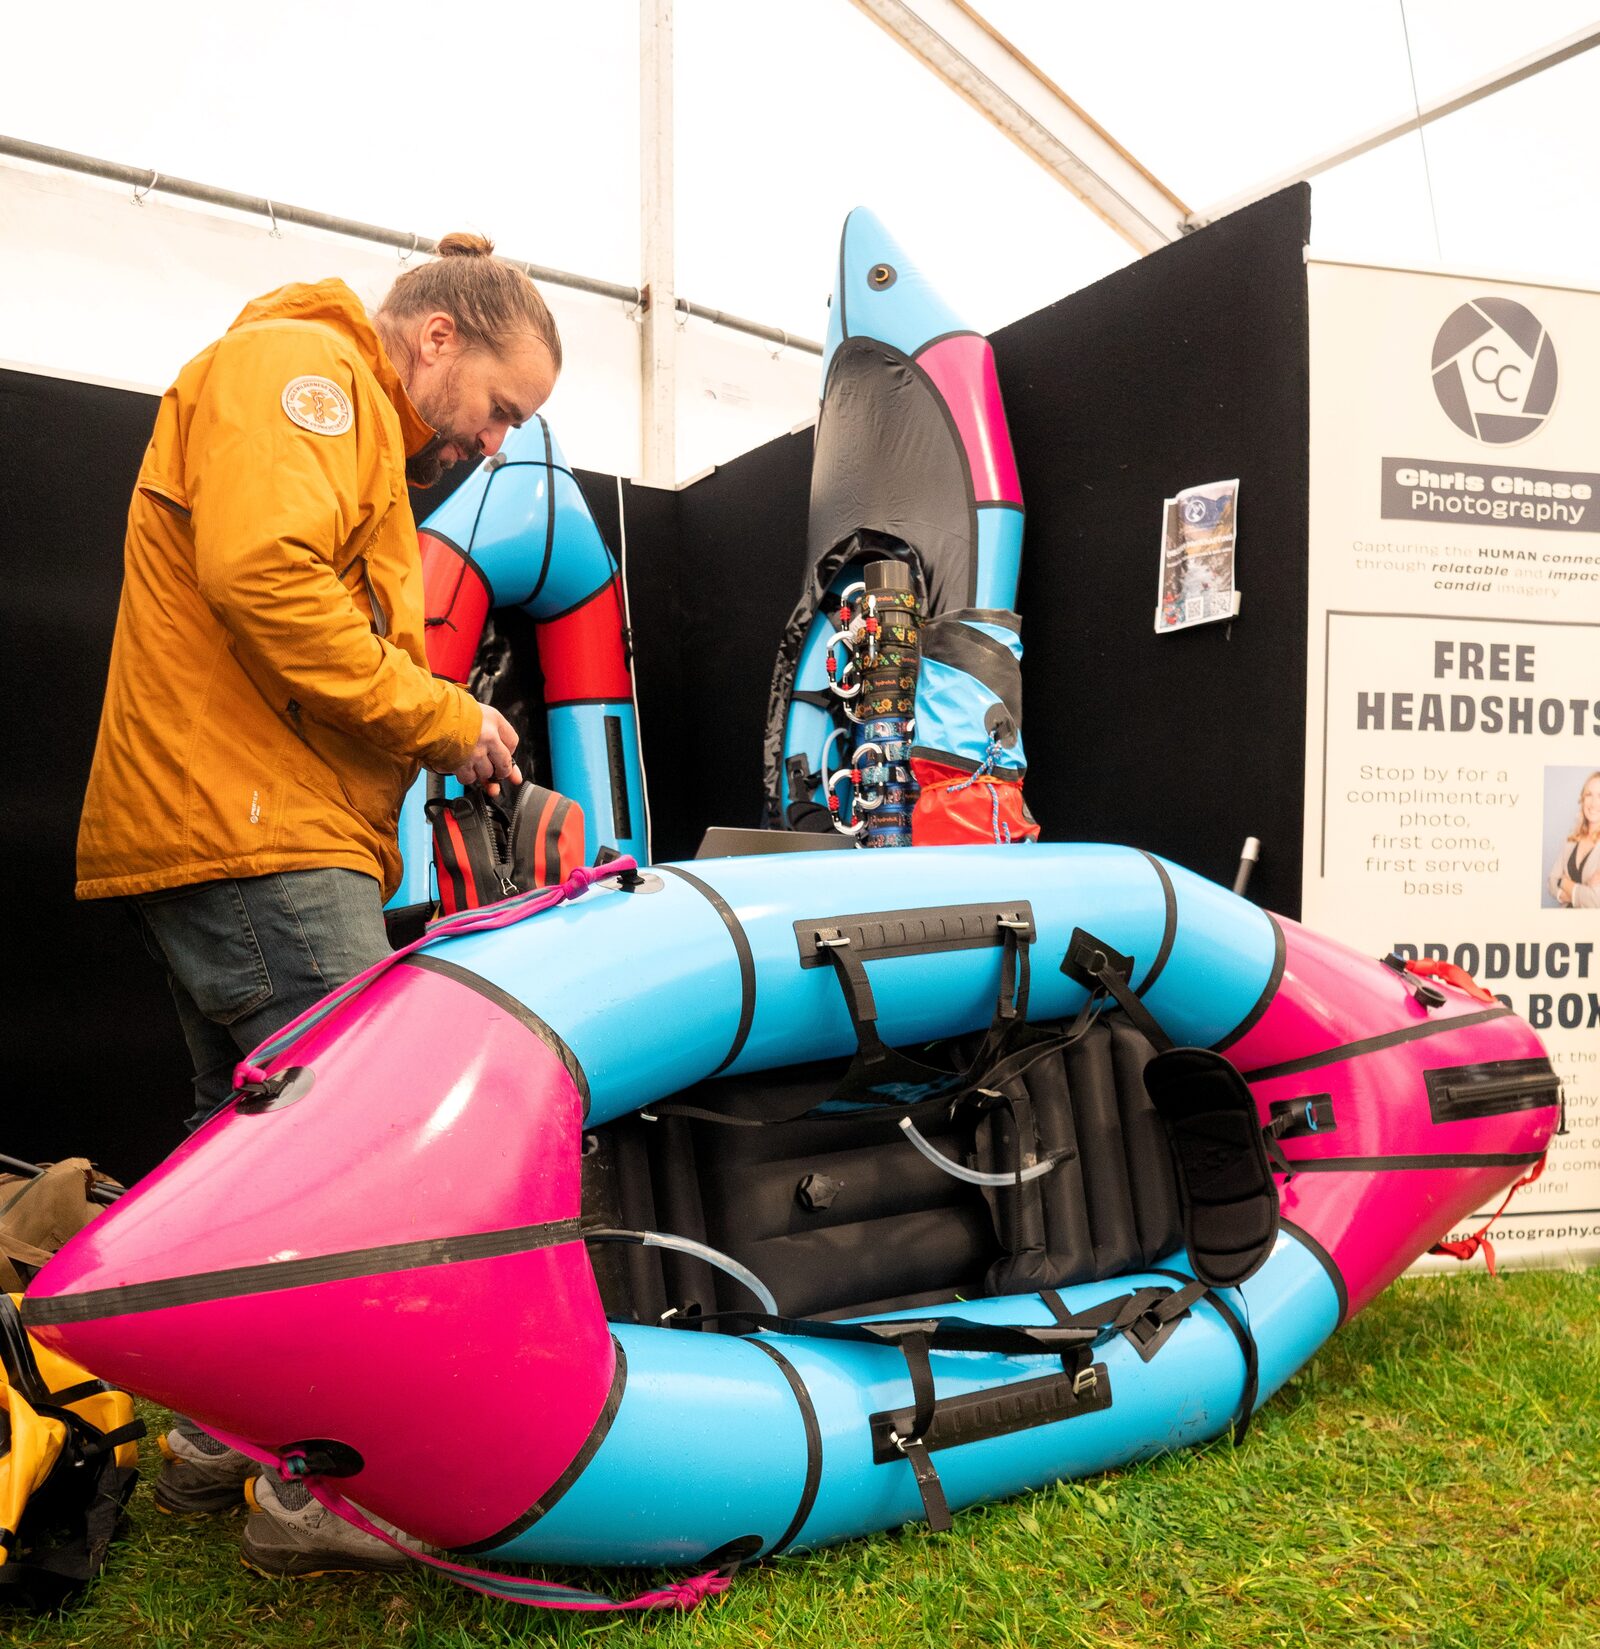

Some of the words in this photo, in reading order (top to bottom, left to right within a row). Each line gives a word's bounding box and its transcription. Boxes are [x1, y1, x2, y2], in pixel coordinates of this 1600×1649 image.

[1472, 345, 1521, 403] CC
[1395, 468, 1485, 492] Chris
[1491, 475, 1592, 500] Chase
[1411, 490, 1586, 525] Photography
[1352, 541, 1439, 557] Capturing
[1445, 545, 1473, 557] the
[1478, 547, 1537, 562] HUMAN
[1542, 553, 1600, 566] connec
[1356, 559, 1426, 574] through
[1432, 562, 1509, 577] relatable
[1515, 567, 1543, 579] and
[1548, 569, 1599, 582] impac
[1433, 580, 1492, 593] candid
[1497, 583, 1560, 598] imagery
[1433, 640, 1535, 683] FREE
[1360, 765, 1415, 783] Stop
[1424, 766, 1449, 784] by
[1457, 767, 1488, 783] for
[1496, 770, 1508, 783] a
[1346, 789, 1520, 808] complimentary
[1400, 812, 1471, 829] photo,
[1371, 834, 1423, 850] first
[1431, 837, 1496, 851] come,
[1366, 857, 1417, 873] first
[1425, 858, 1500, 873] served
[1403, 880, 1464, 896] basis
[1549, 1138, 1586, 1150] duct
[1538, 1182, 1569, 1194] life!
